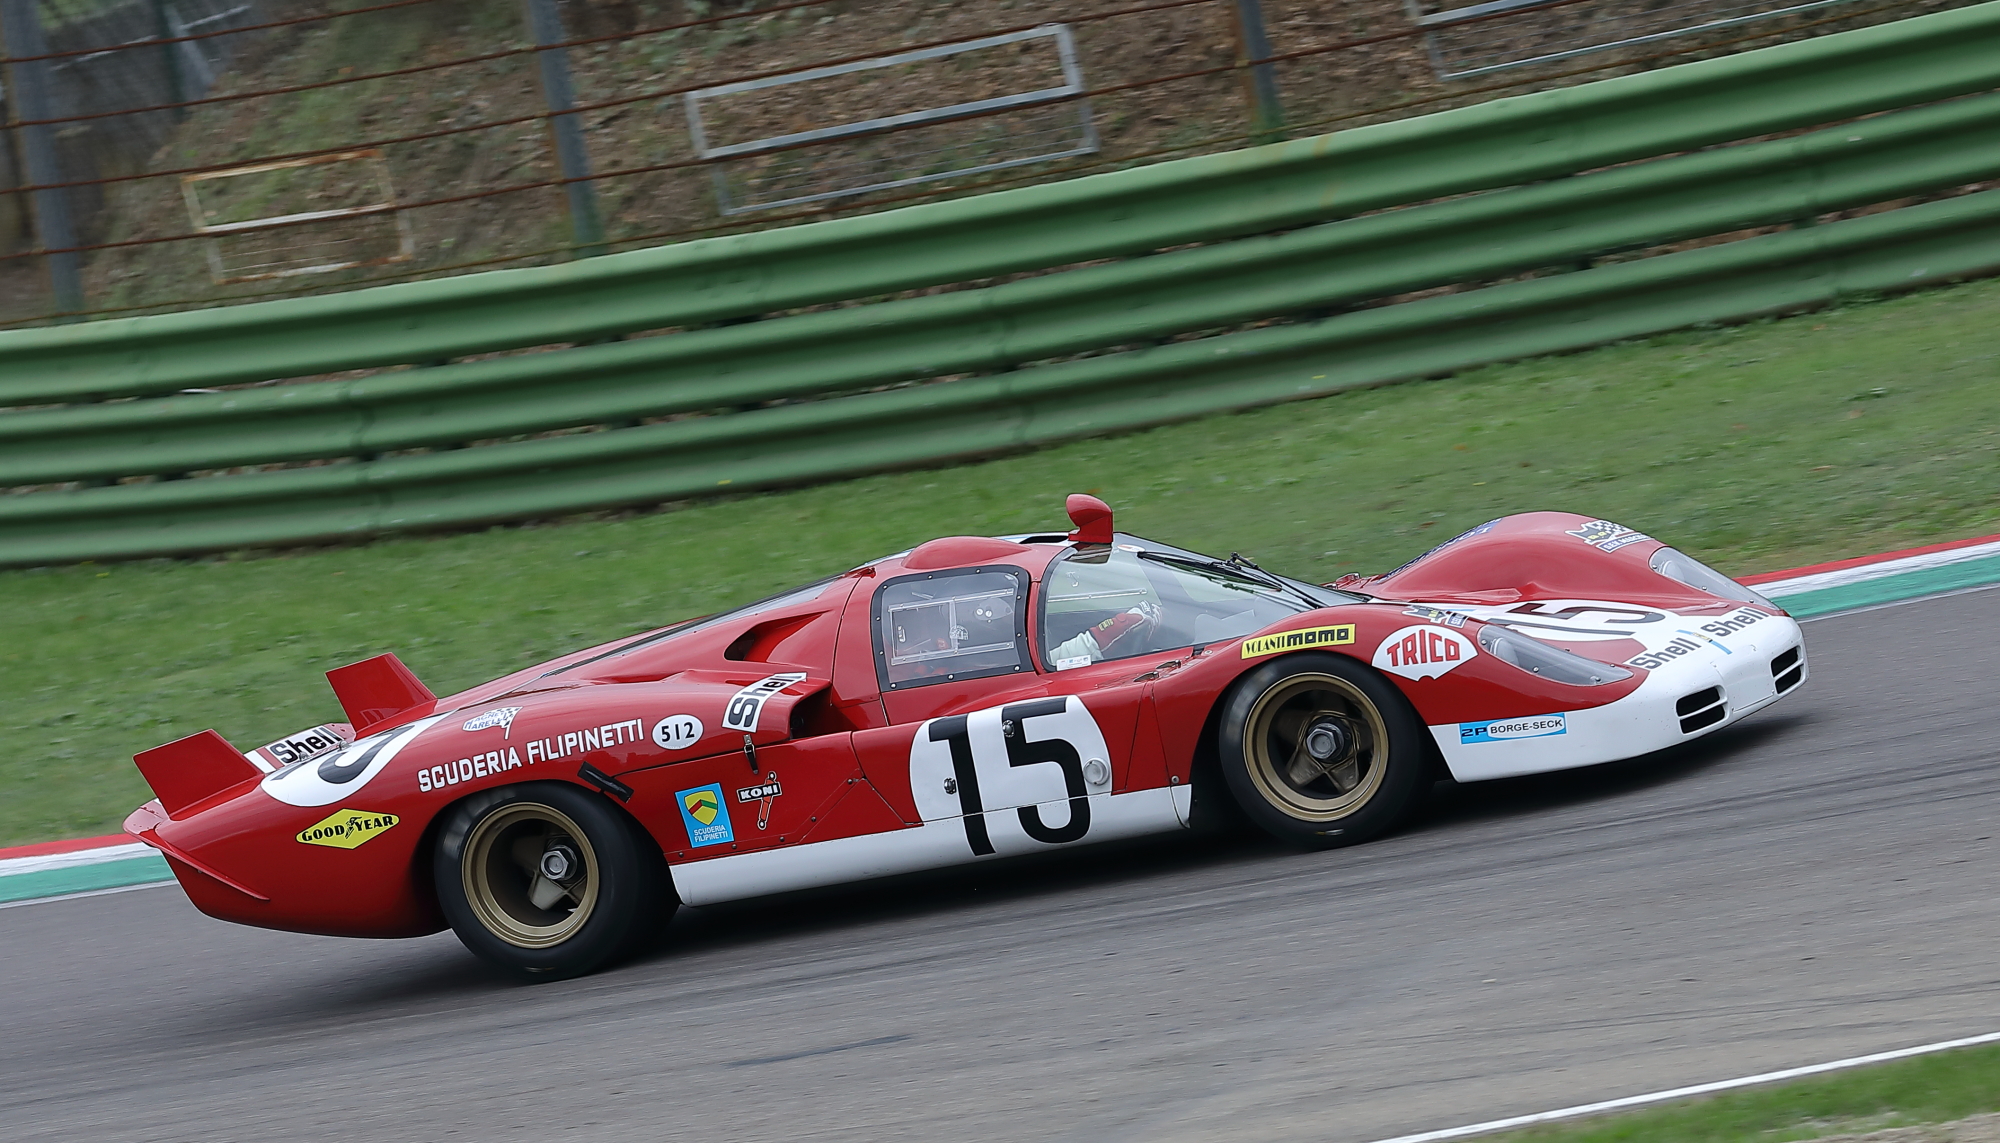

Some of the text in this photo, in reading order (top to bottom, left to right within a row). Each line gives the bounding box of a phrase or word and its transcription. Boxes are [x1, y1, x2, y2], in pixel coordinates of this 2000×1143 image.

[1700, 607, 1770, 637] Shell
[1245, 635, 1285, 655] VOLANTI
[1386, 628, 1461, 668] TRICO
[1629, 637, 1702, 670] Shell
[728, 675, 803, 728] Shell
[661, 721, 695, 743] 512
[1490, 719, 1563, 734] BORGE-SECK
[269, 726, 343, 764] Shell
[417, 747, 523, 793] SCUDERIA
[526, 718, 645, 765] FILIPINETTI
[928, 696, 1092, 857] 15
[739, 784, 779, 800] KONI
[693, 824, 726, 836] SCUDERIA
[694, 830, 729, 842] FILIPINETTI
